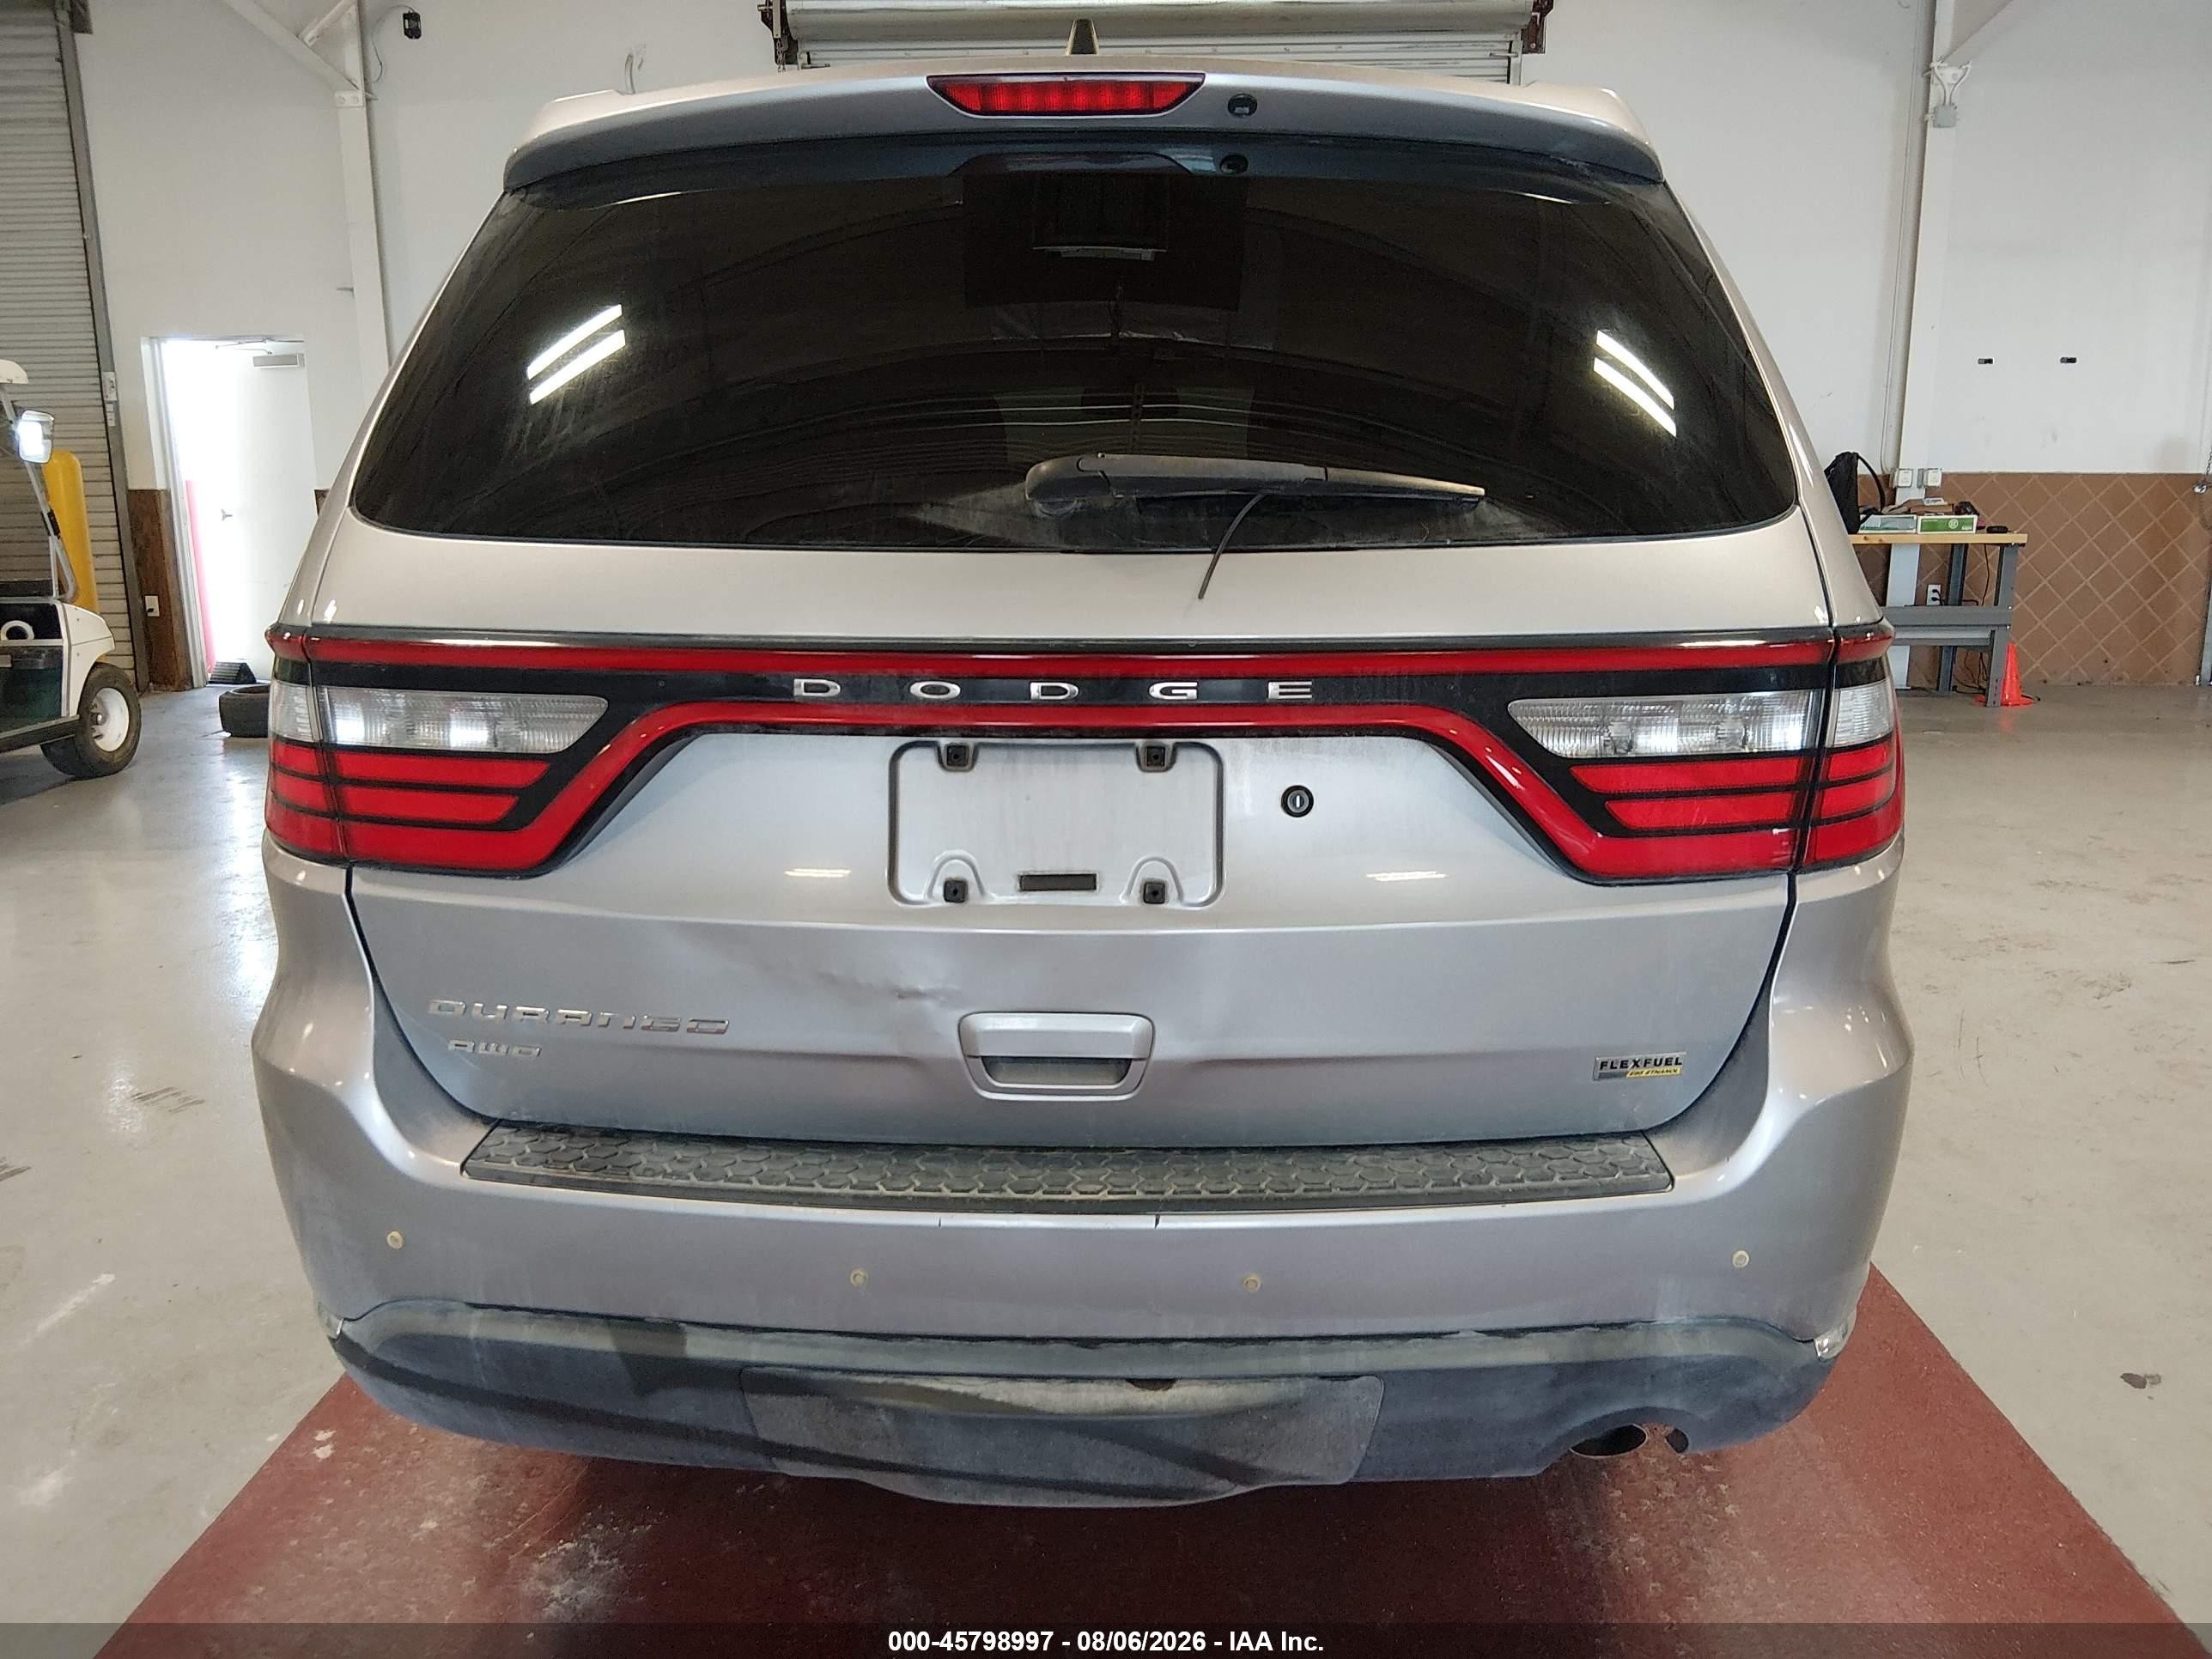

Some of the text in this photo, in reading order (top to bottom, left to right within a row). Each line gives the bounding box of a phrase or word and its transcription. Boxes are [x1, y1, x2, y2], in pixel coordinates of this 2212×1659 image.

[793, 678, 1314, 701] DODGE
[448, 1039, 542, 1058] AWD
[1600, 1056, 1682, 1070] FLEXFUEL
